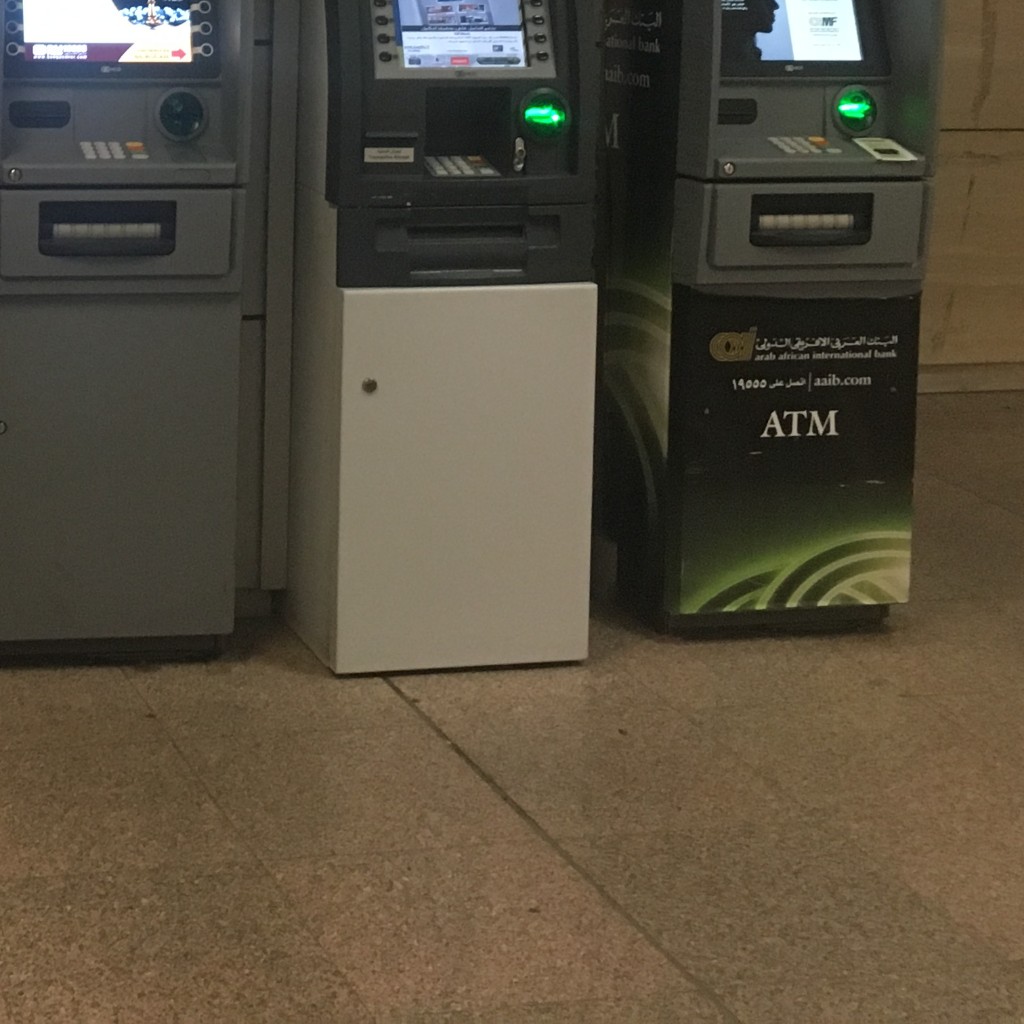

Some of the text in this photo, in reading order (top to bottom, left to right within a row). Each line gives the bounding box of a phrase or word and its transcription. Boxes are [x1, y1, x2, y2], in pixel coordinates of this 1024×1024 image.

[638, 36, 661, 53] bank
[754, 349, 897, 361] arab african international bank
[814, 373, 872, 387] aaib.com
[760, 410, 839, 438] ATM
